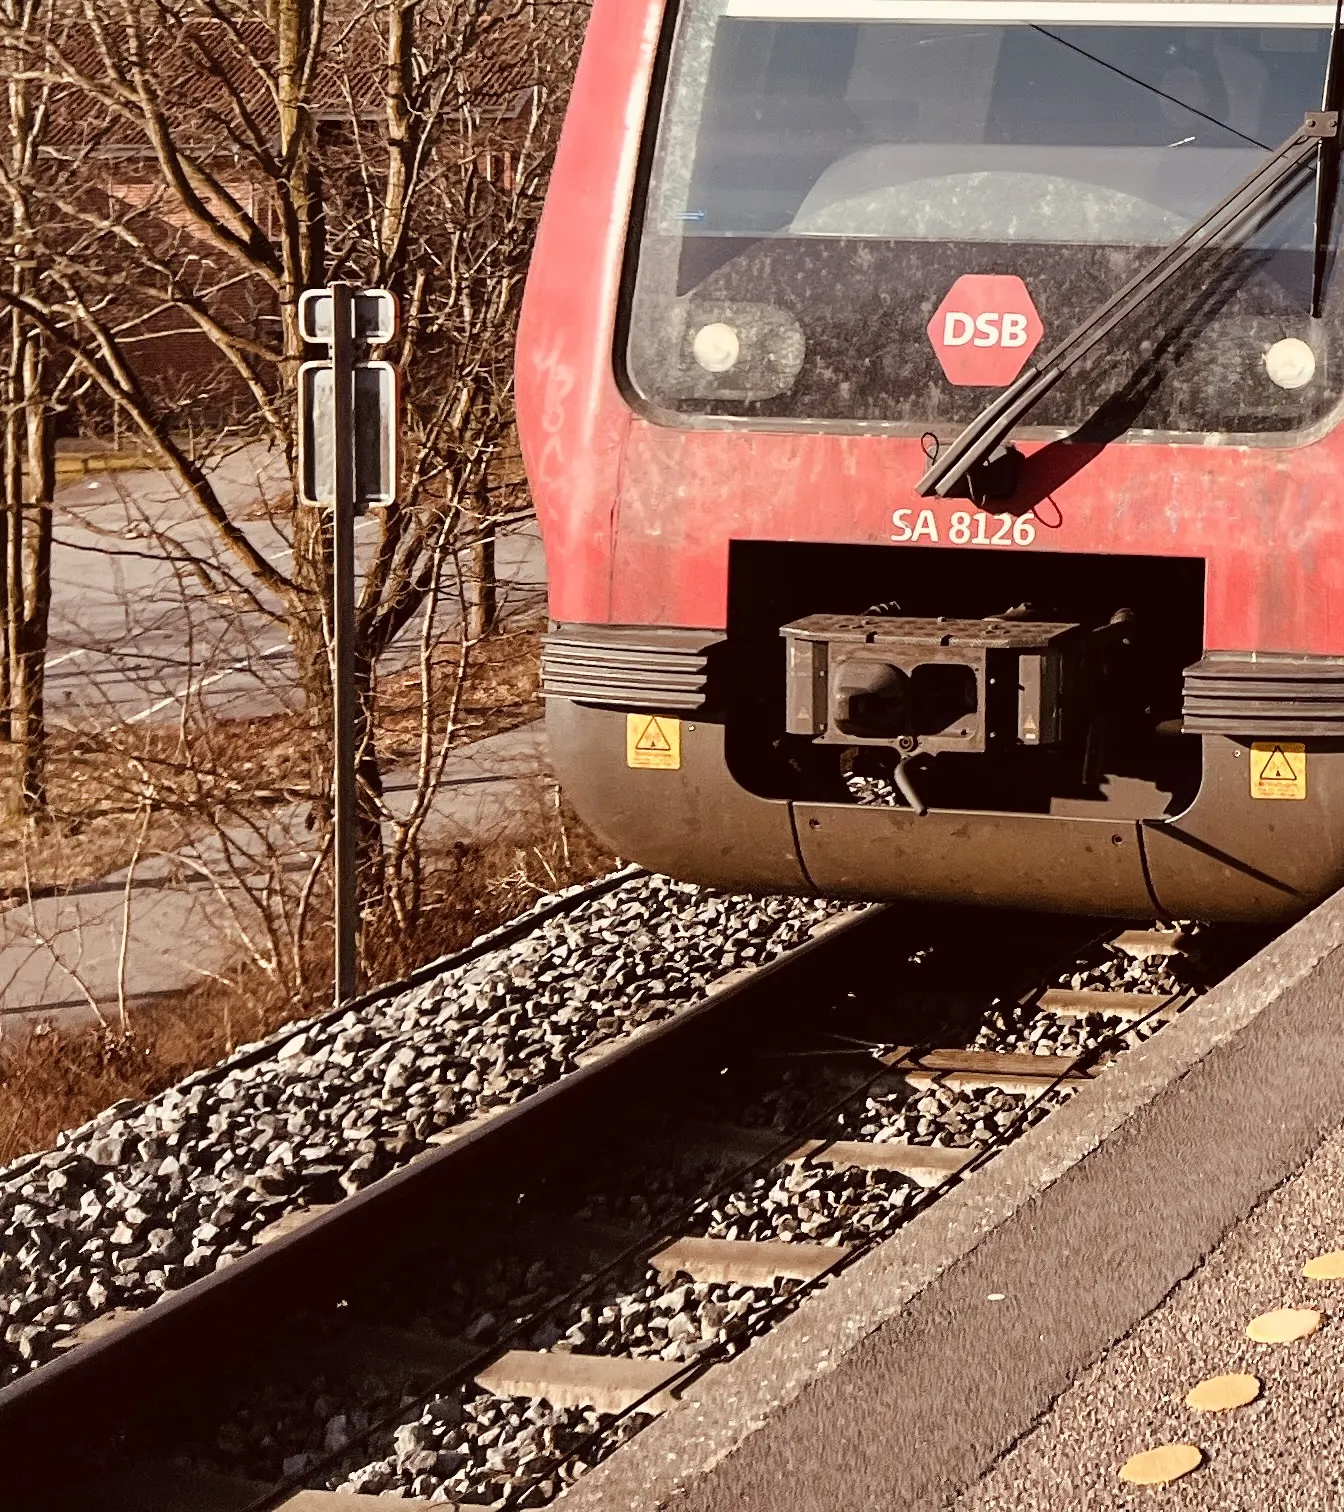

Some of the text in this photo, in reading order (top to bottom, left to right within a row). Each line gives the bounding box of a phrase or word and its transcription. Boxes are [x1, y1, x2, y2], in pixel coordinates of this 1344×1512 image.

[943, 311, 1028, 348] DSB
[890, 508, 1036, 546] SA 8126
